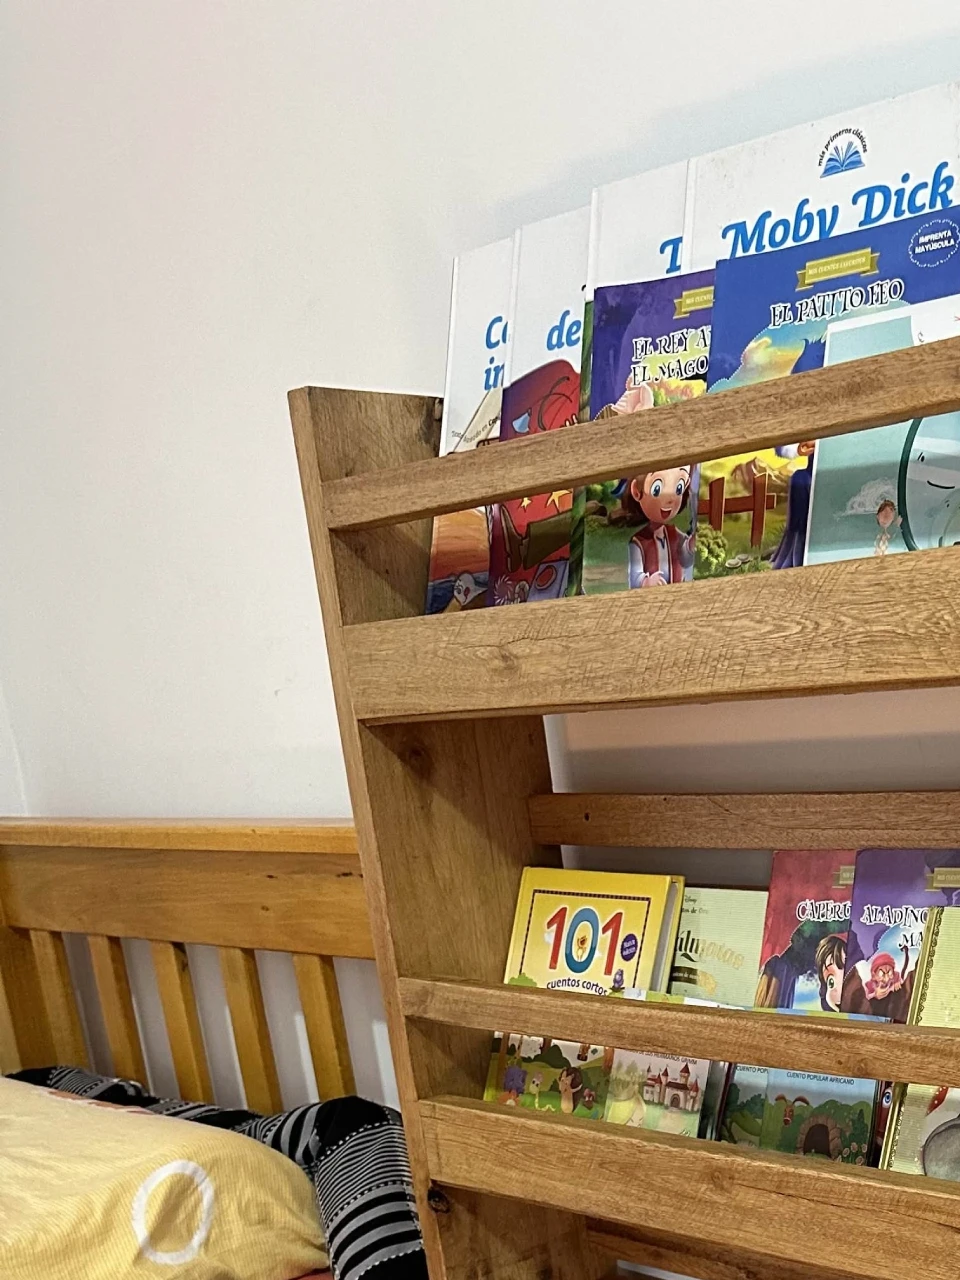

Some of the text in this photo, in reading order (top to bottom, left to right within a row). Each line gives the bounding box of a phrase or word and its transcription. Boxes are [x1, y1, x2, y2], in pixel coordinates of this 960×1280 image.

[824, 128, 852, 152] primeros
[852, 128, 868, 153] clásicos
[722, 161, 955, 260] Moby Dick
[914, 238, 955, 254] MAYÚSCULA
[918, 229, 952, 244] IMPRENTA
[770, 279, 904, 327] EL PATITO FEO
[633, 326, 711, 361] EL REY A
[632, 355, 709, 387] EL MAGO
[546, 906, 623, 976] 101
[546, 977, 608, 997] cuentos cortos
[786, 1071, 855, 1086] CUENTO POPULAR AFRICANO
